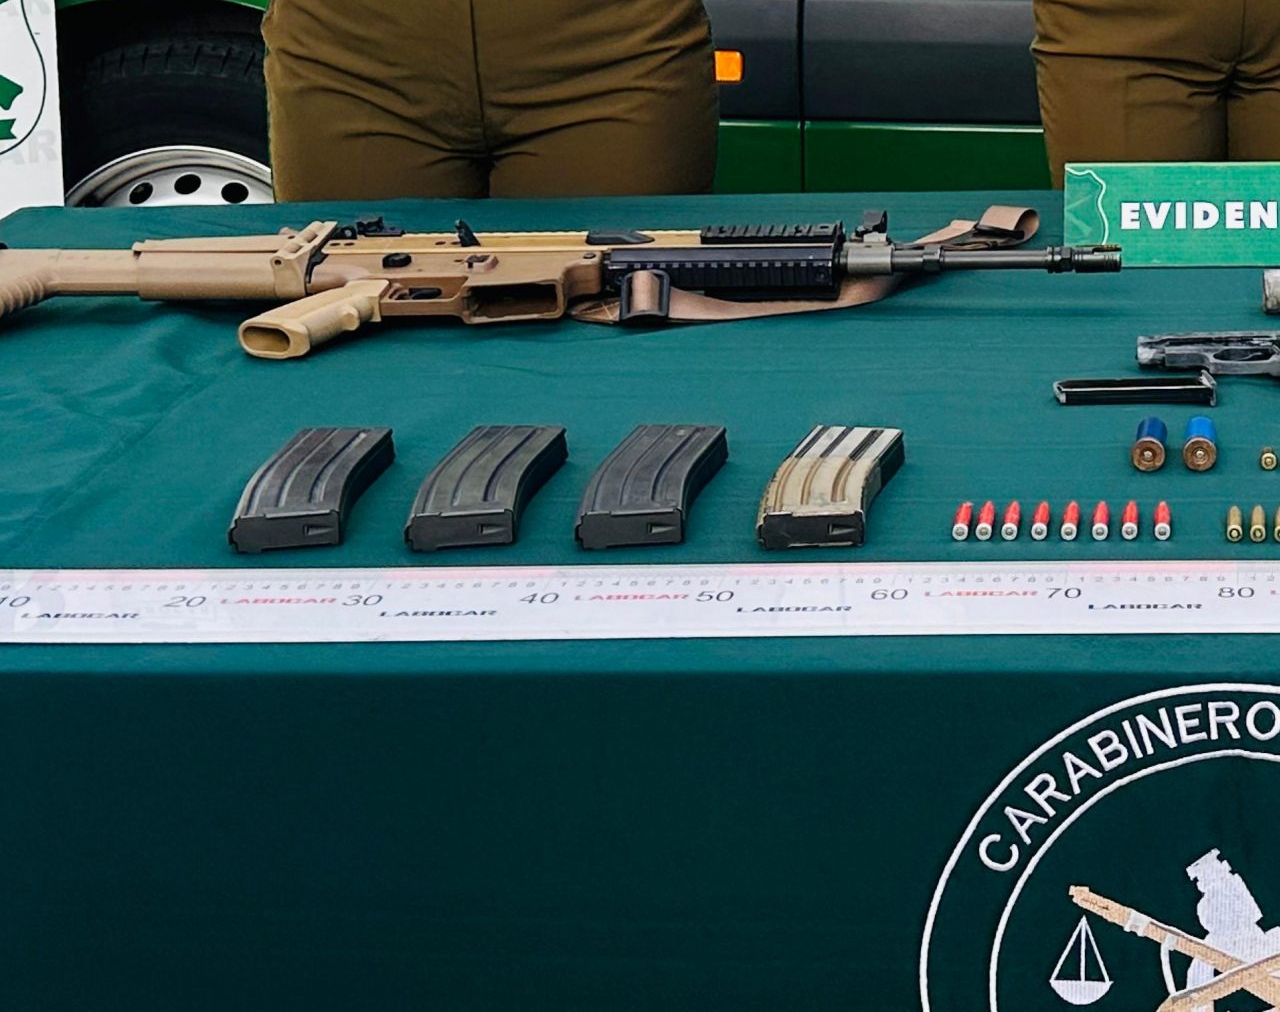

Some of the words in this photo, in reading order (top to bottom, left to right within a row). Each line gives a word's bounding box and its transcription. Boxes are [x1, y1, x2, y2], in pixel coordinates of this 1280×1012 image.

[162, 596, 208, 608] 20
[342, 594, 384, 606] 30
[520, 592, 560, 604] 40
[696, 590, 734, 602] 50
[870, 588, 908, 600] 60
[1046, 588, 1082, 600] 70
[1218, 586, 1256, 598] 80
